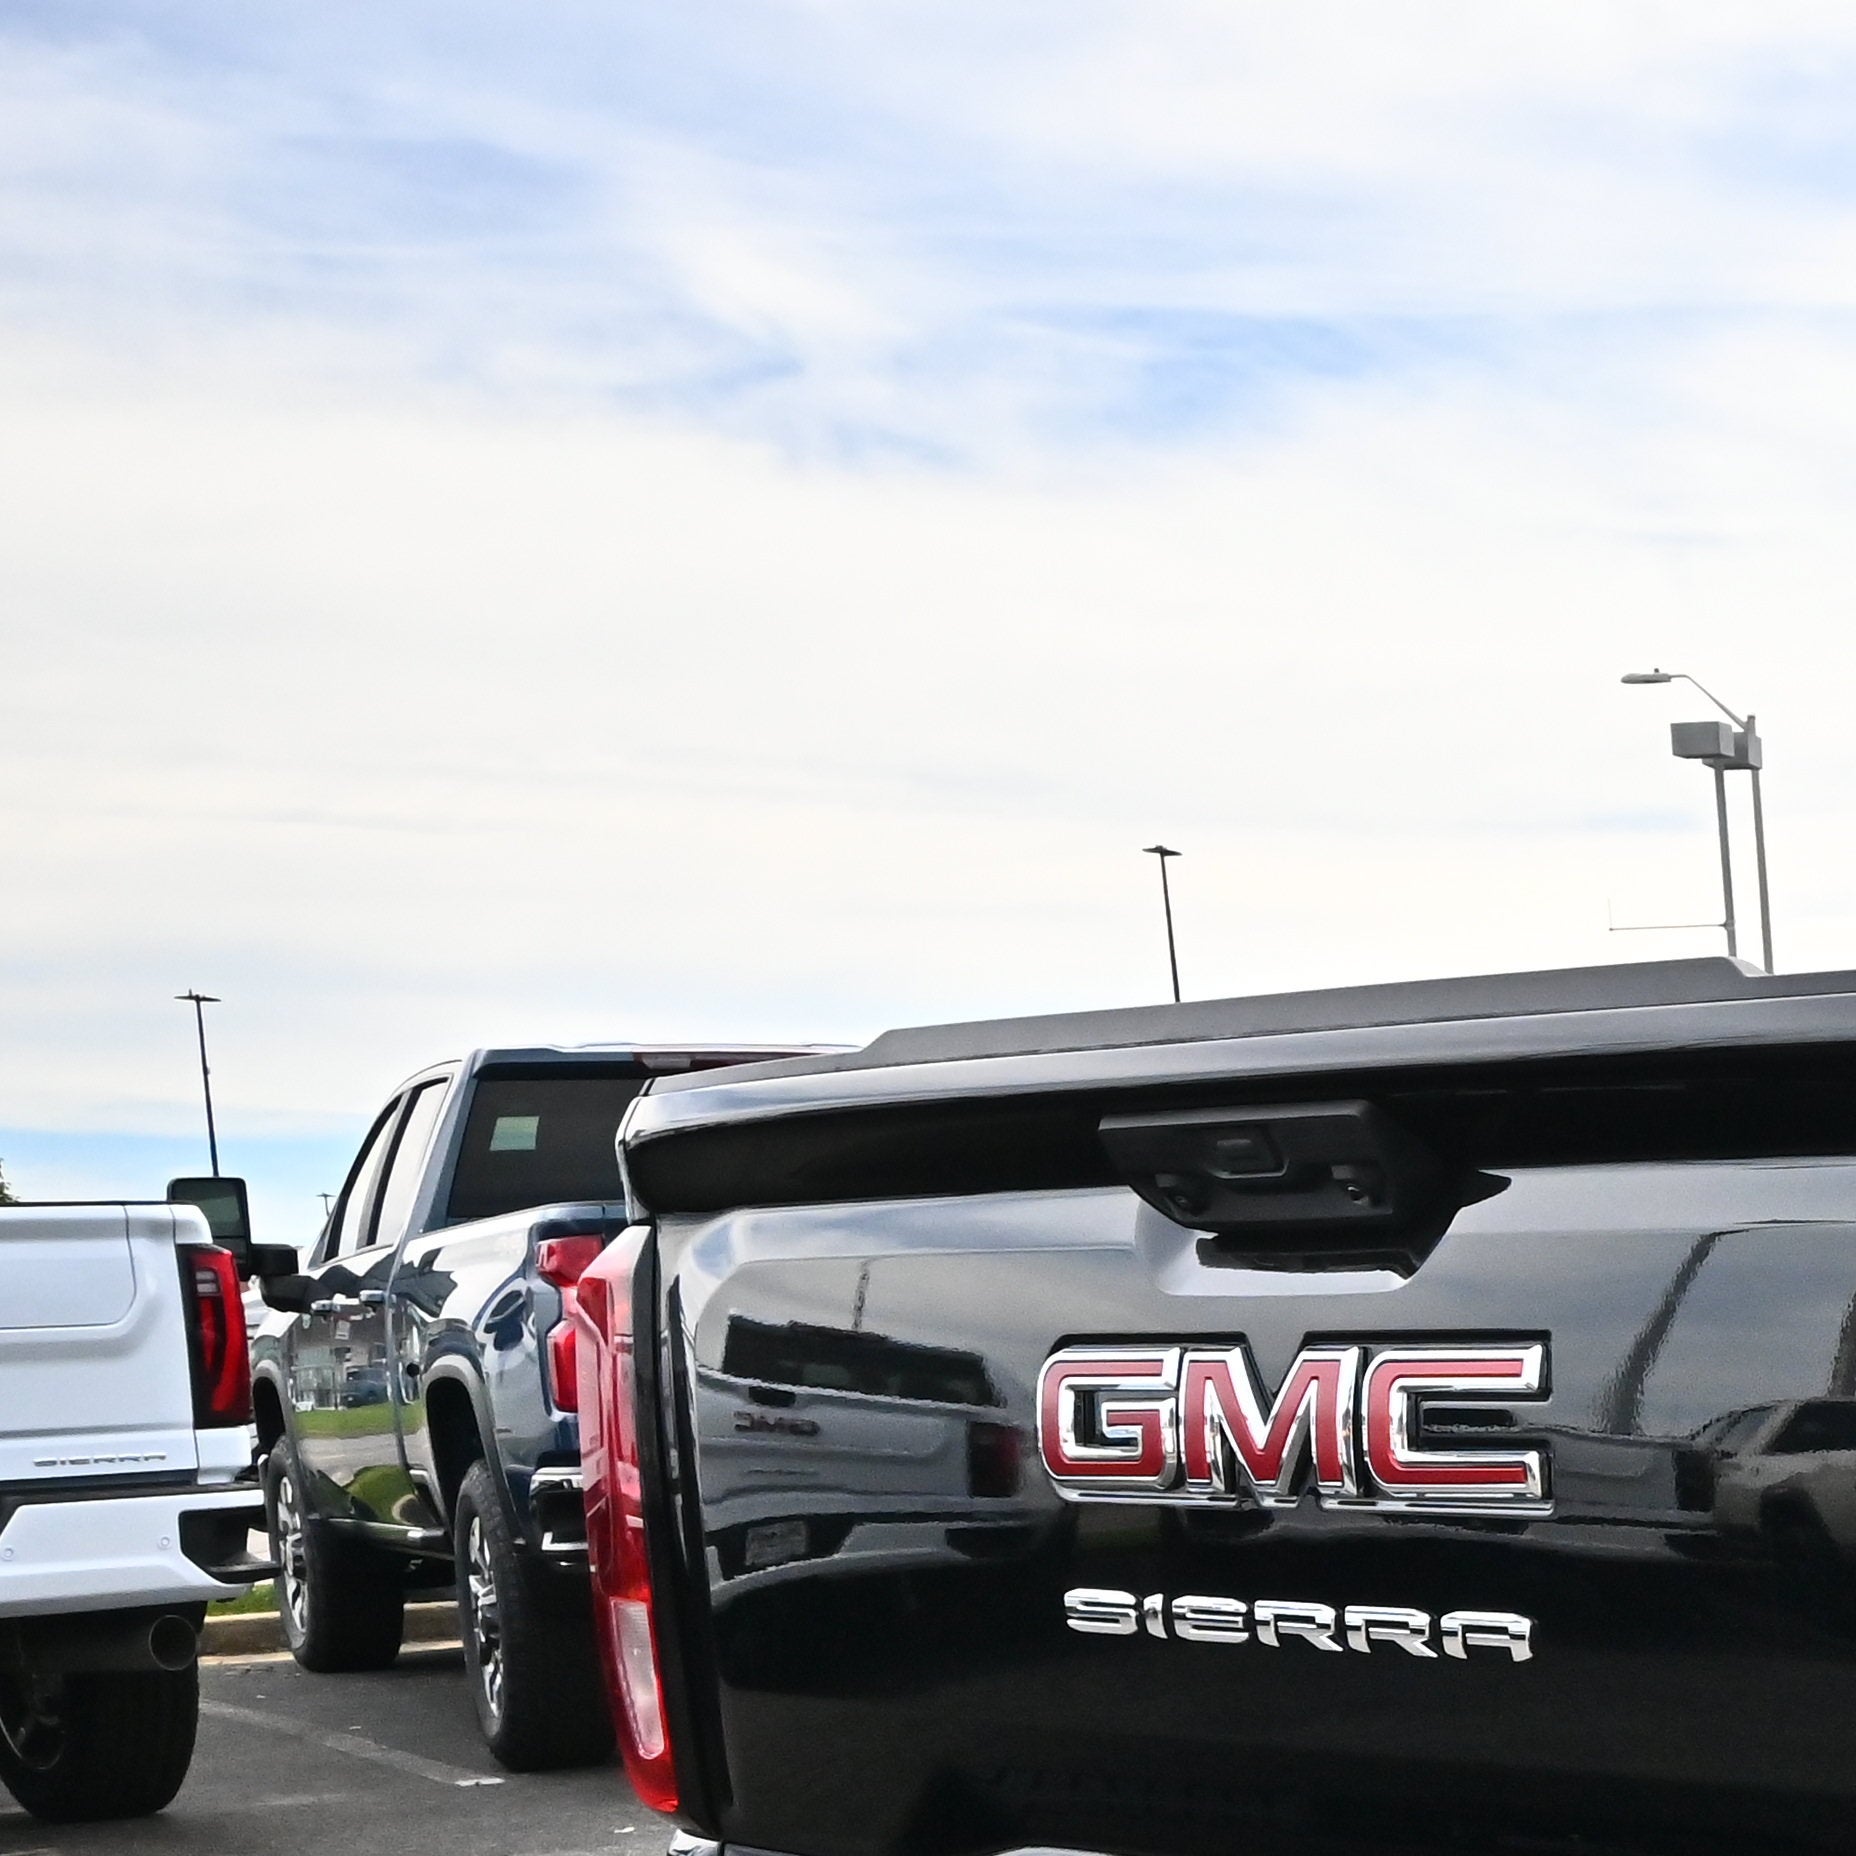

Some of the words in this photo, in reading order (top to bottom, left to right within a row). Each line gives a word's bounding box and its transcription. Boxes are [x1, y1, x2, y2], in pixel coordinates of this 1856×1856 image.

[33, 1452, 167, 1467] SIERRA
[1038, 1344, 1553, 1512] GMC
[1063, 1588, 1536, 1664] SIERRA
